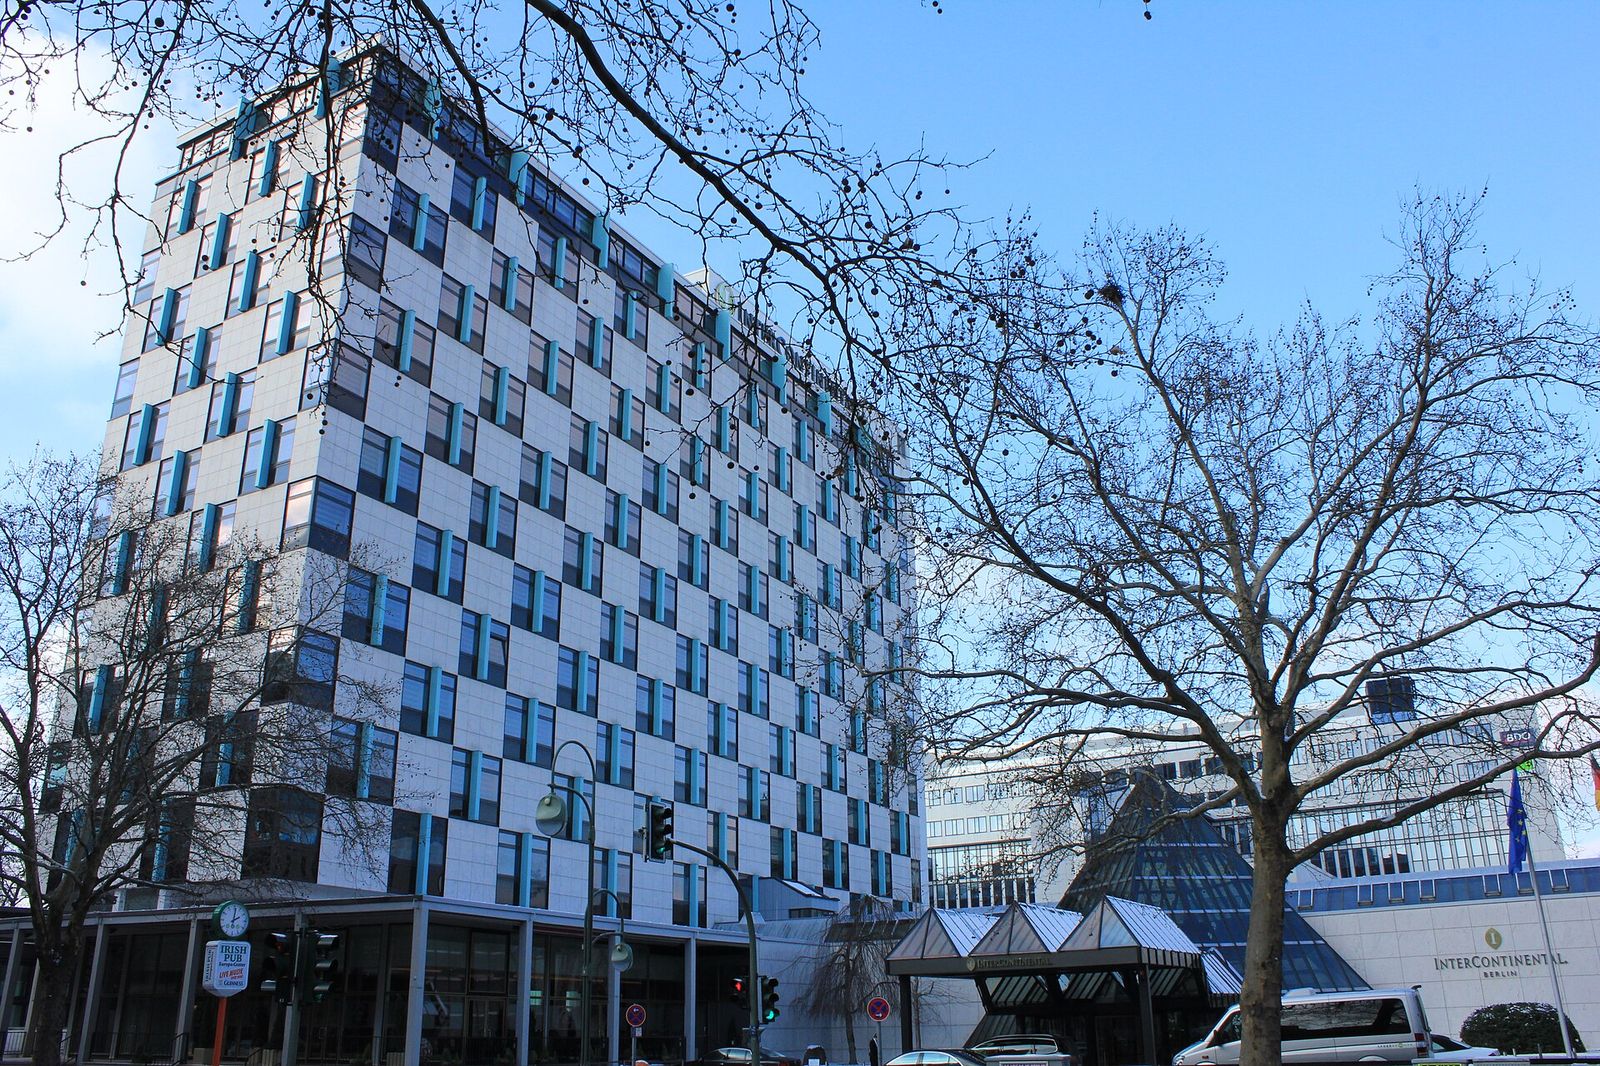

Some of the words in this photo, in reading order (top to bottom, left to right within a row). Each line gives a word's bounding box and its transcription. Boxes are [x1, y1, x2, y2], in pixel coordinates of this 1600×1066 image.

[221, 945, 247, 954] IRISH
[223, 954, 242, 962] PUB
[1483, 970, 1518, 978] BERLIN
